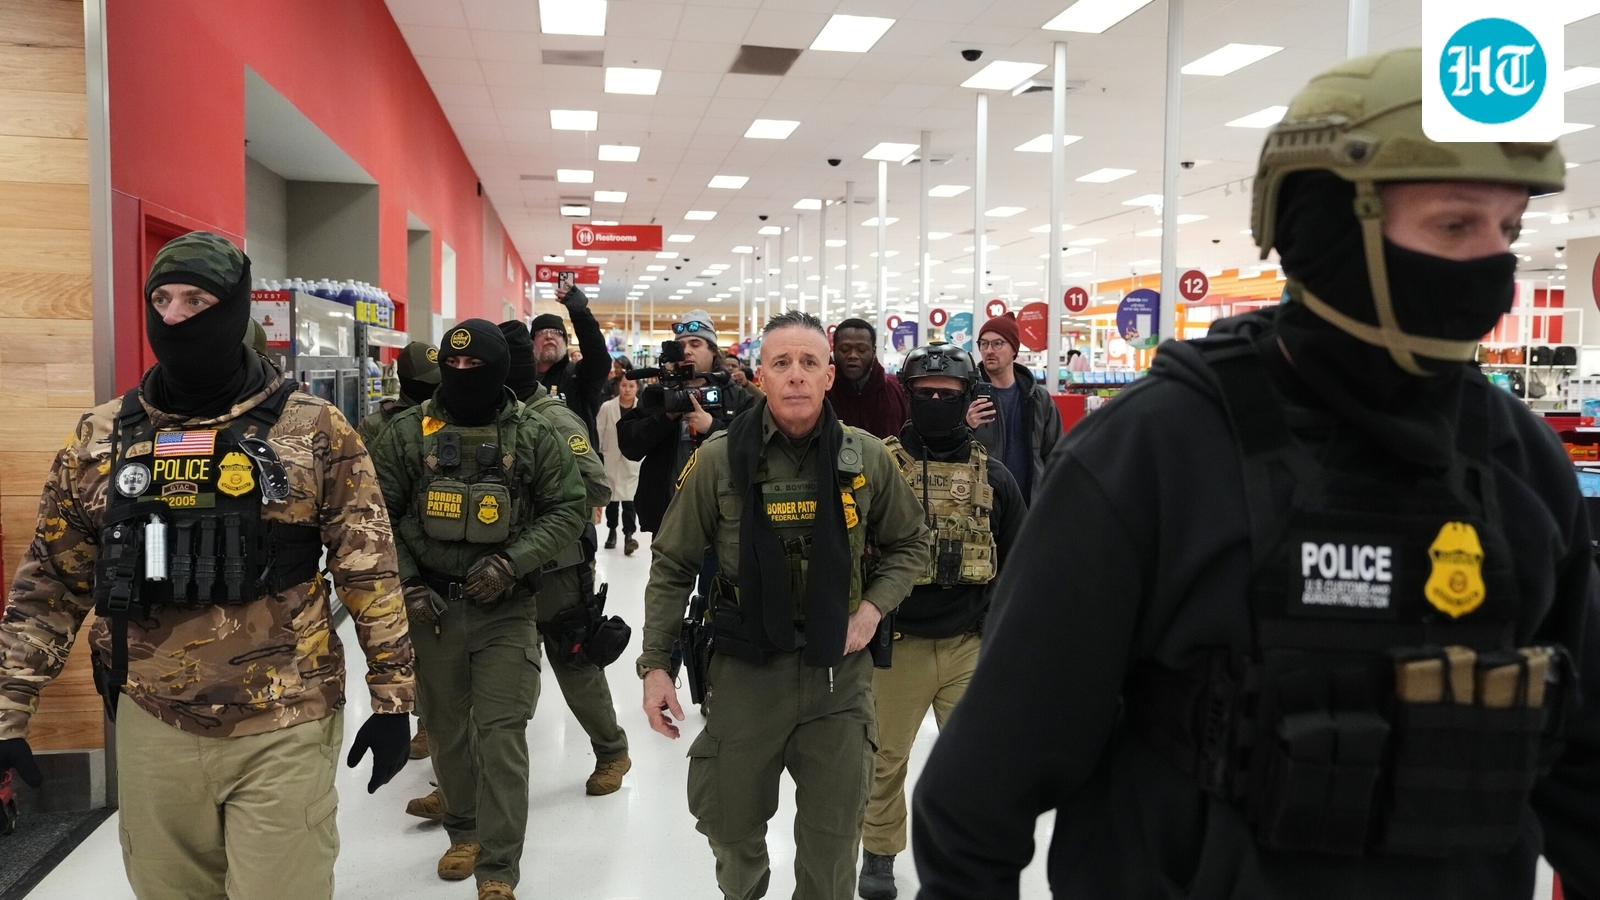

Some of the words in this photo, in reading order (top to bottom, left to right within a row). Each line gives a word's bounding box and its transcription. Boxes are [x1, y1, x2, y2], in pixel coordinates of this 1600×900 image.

[595, 233, 637, 242] Restrooms
[1184, 278, 1203, 293] 12
[1069, 293, 1083, 306] 11
[989, 304, 1003, 316] 10
[153, 459, 211, 481] POLICE
[786, 483, 816, 491] BOVINO
[428, 490, 463, 504] BORDER
[427, 500, 461, 513] PATROL
[767, 502, 796, 515] BORDER
[797, 500, 818, 513] PATR
[426, 510, 446, 518] FEDERAL
[1301, 541, 1393, 583] POLICE
[1323, 579, 1371, 595] CUSTOMS
